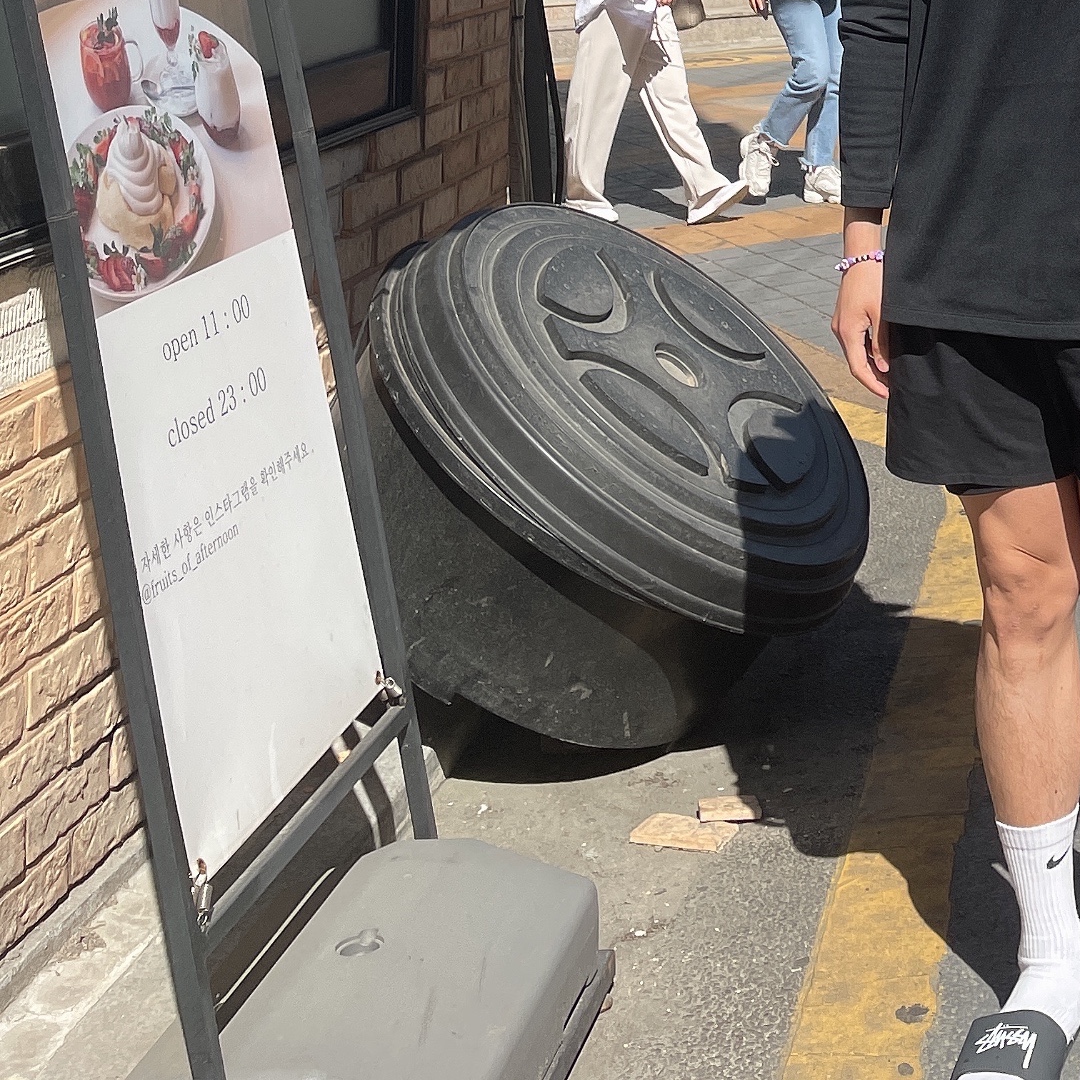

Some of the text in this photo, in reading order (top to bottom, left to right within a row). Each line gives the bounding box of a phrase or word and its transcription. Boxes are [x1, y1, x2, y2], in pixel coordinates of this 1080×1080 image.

[162, 328, 199, 362] open
[167, 398, 216, 449] closed
[140, 537, 171, 573] 자세한
[172, 515, 203, 552] 사항은
[204, 475, 259, 521] 인스타그램을
[141, 522, 240, 606] @fruits_of_afternoon
